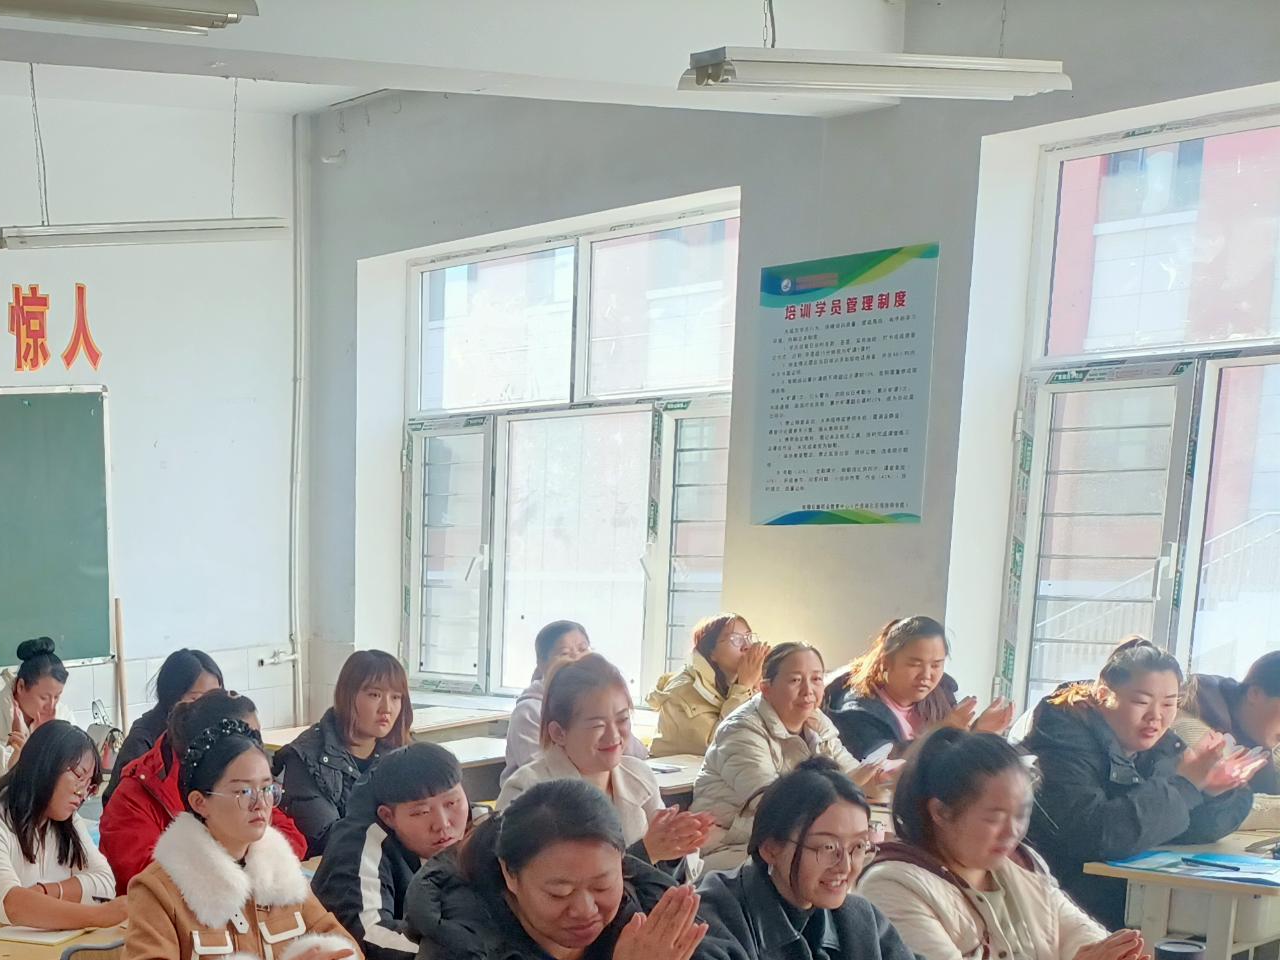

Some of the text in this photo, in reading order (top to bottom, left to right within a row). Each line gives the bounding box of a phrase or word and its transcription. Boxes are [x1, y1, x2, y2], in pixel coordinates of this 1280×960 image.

[785, 291, 906, 320] 培训学员管理制度
